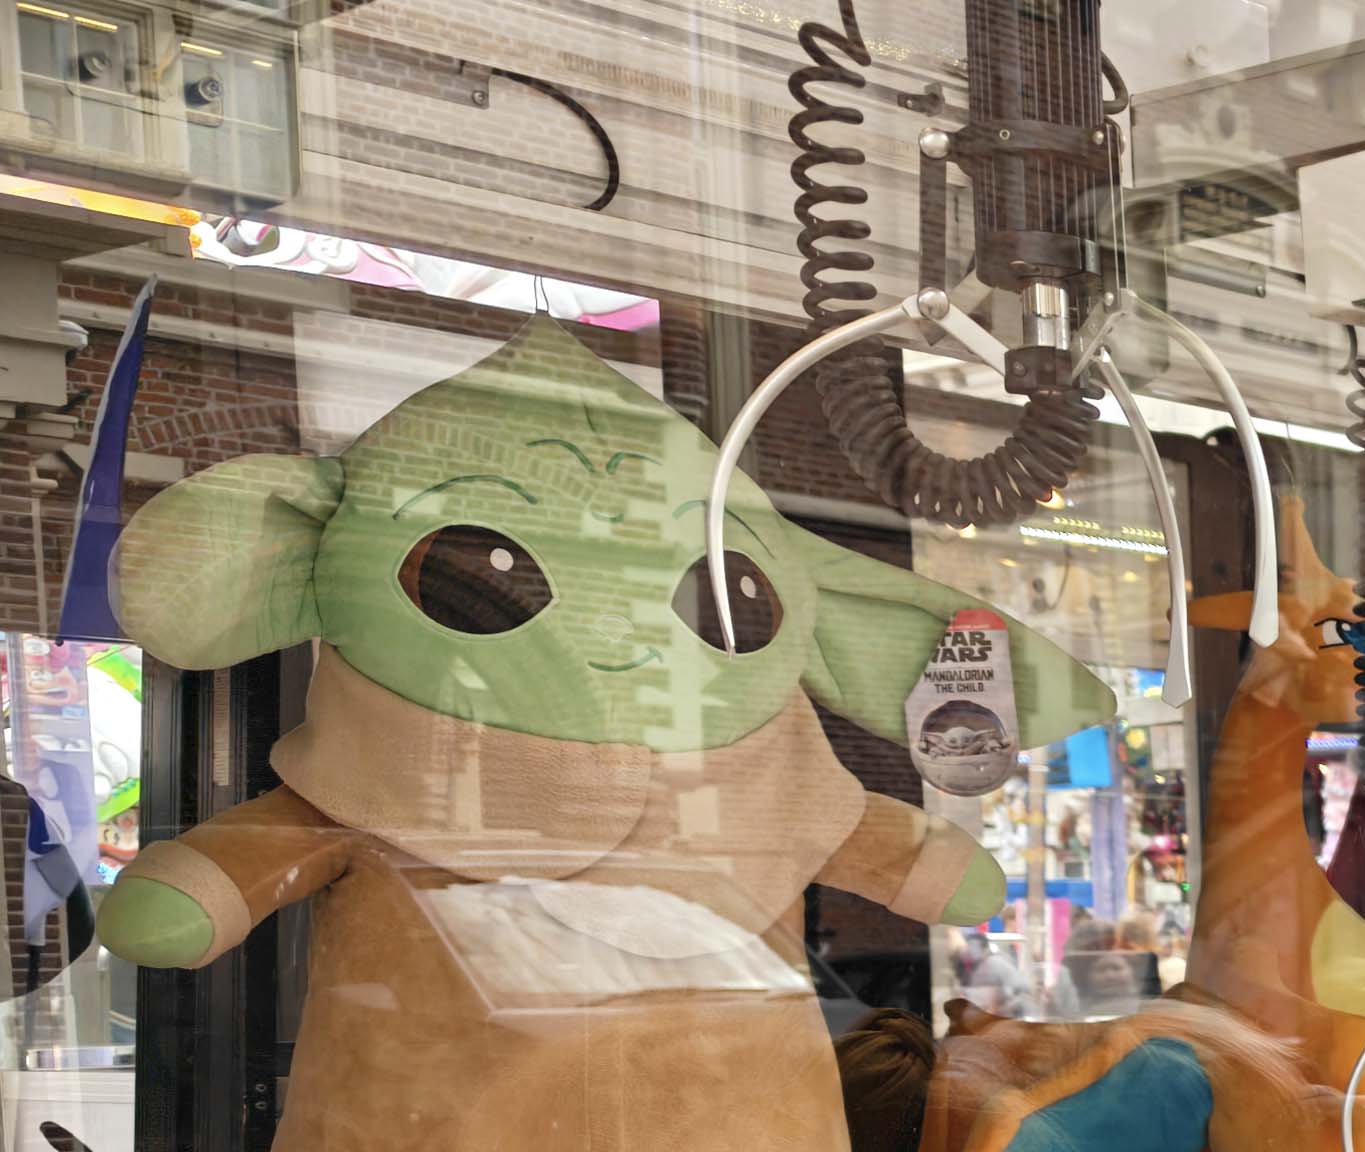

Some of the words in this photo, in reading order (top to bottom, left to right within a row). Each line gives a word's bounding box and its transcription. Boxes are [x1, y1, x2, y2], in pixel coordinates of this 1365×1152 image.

[941, 631, 992, 647] TAR
[923, 669, 994, 682] MANDALORIAN
[934, 683, 954, 694] THE
[956, 681, 985, 693] CHILD
